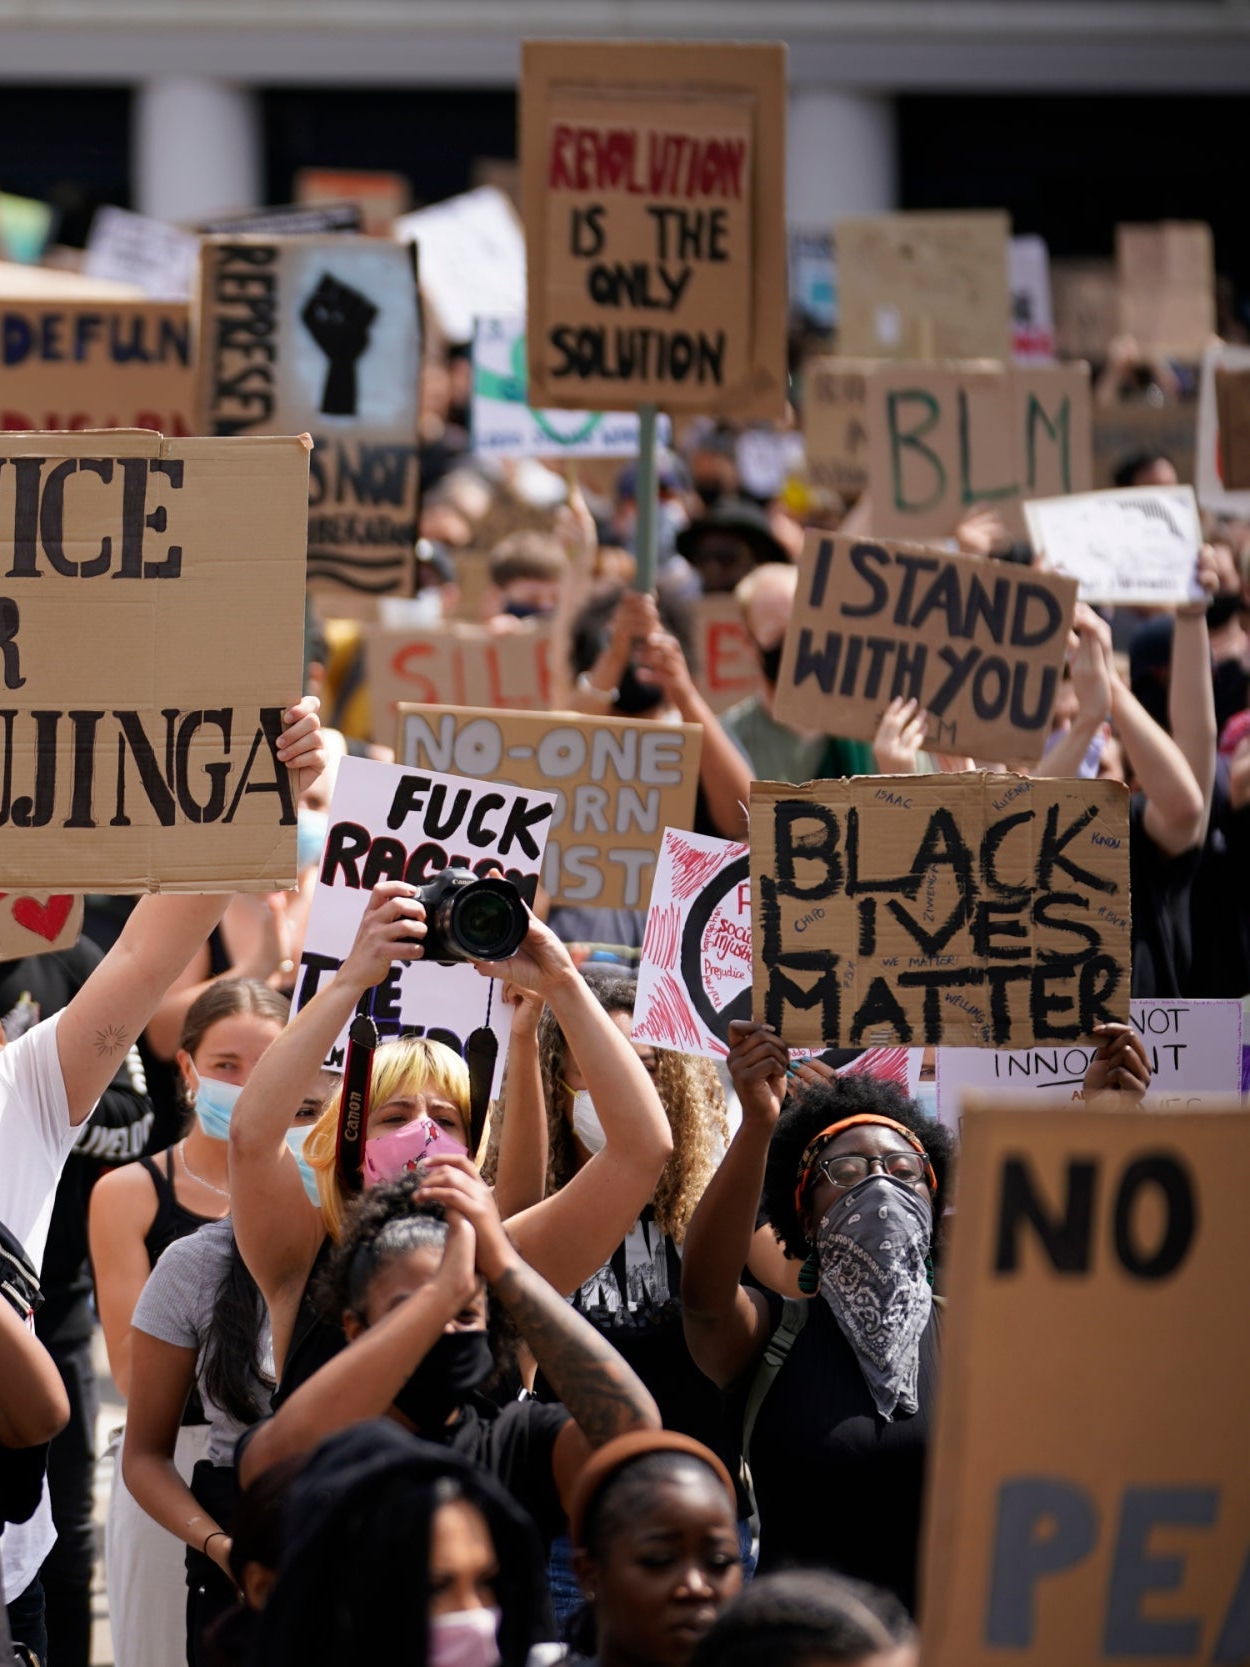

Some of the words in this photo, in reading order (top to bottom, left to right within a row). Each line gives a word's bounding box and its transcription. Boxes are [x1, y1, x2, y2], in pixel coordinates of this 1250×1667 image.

[550, 125, 746, 198] REVOLUTION
[571, 204, 606, 257] IS
[646, 204, 729, 262] THE
[588, 261, 692, 314] ONLY
[0, 312, 190, 368] DEFUN
[550, 324, 725, 387] SOLUTION
[886, 383, 1072, 514] BLM
[809, 539, 833, 608] I
[840, 544, 1063, 647] STAND
[793, 628, 930, 703] WITH
[926, 644, 1058, 731] YOU
[403, 713, 686, 786] NO-ONE
[387, 774, 554, 861] FUCK
[773, 800, 1119, 900] BLACK
[760, 874, 1104, 970] LIVES
[704, 958, 746, 981] Prejudice
[883, 957, 900, 967] WE
[764, 955, 1124, 1047] MATTER
[1130, 1007, 1190, 1035] NOT
[344, 1091, 362, 1142] Canon
[993, 1150, 1200, 1284] NO
